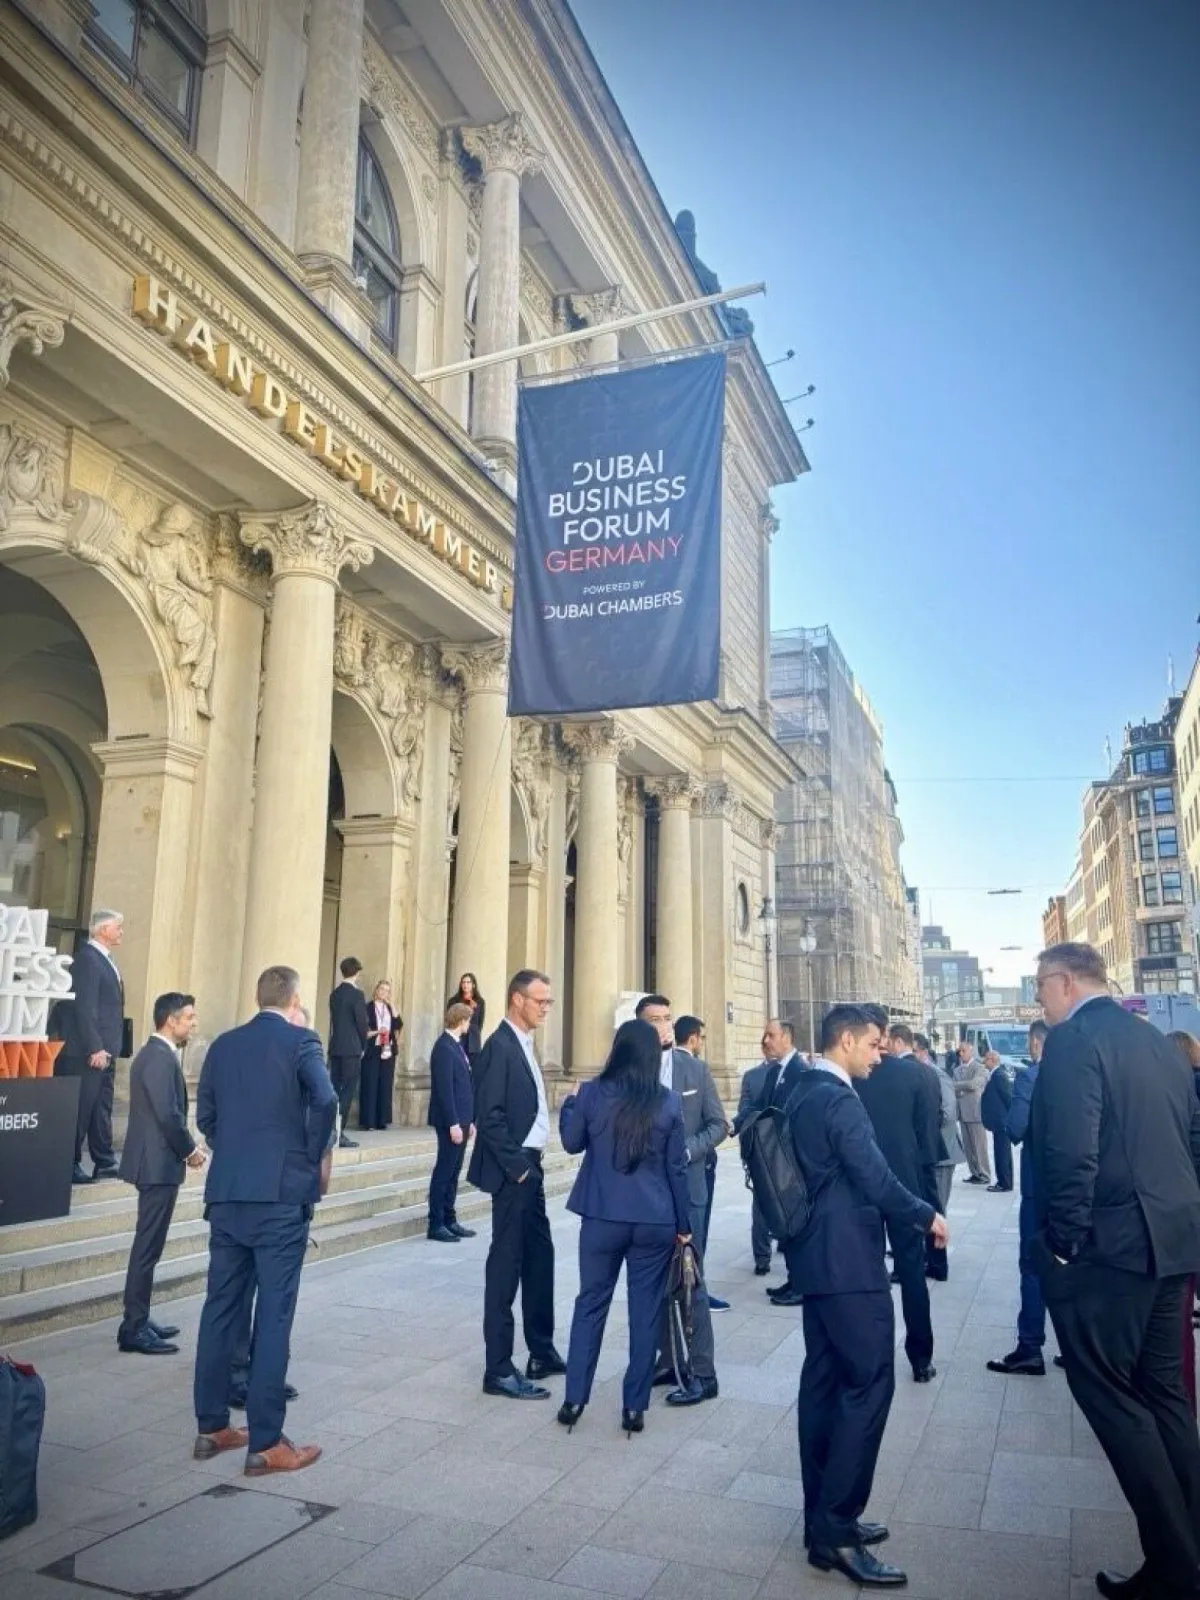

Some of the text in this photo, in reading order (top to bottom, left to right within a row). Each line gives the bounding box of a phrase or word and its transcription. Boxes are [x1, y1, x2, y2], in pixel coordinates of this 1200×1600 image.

[132, 273, 498, 592] HANDELSKAMMER
[572, 449, 664, 487] DUBAI
[548, 475, 687, 518] BUSINESS
[563, 507, 671, 545] FORUM
[545, 535, 683, 573] GERMANY
[543, 590, 685, 620] DUBAI CHAMBERS
[583, 579, 646, 596] POWERED BY
[0, 949, 74, 994] ESS
